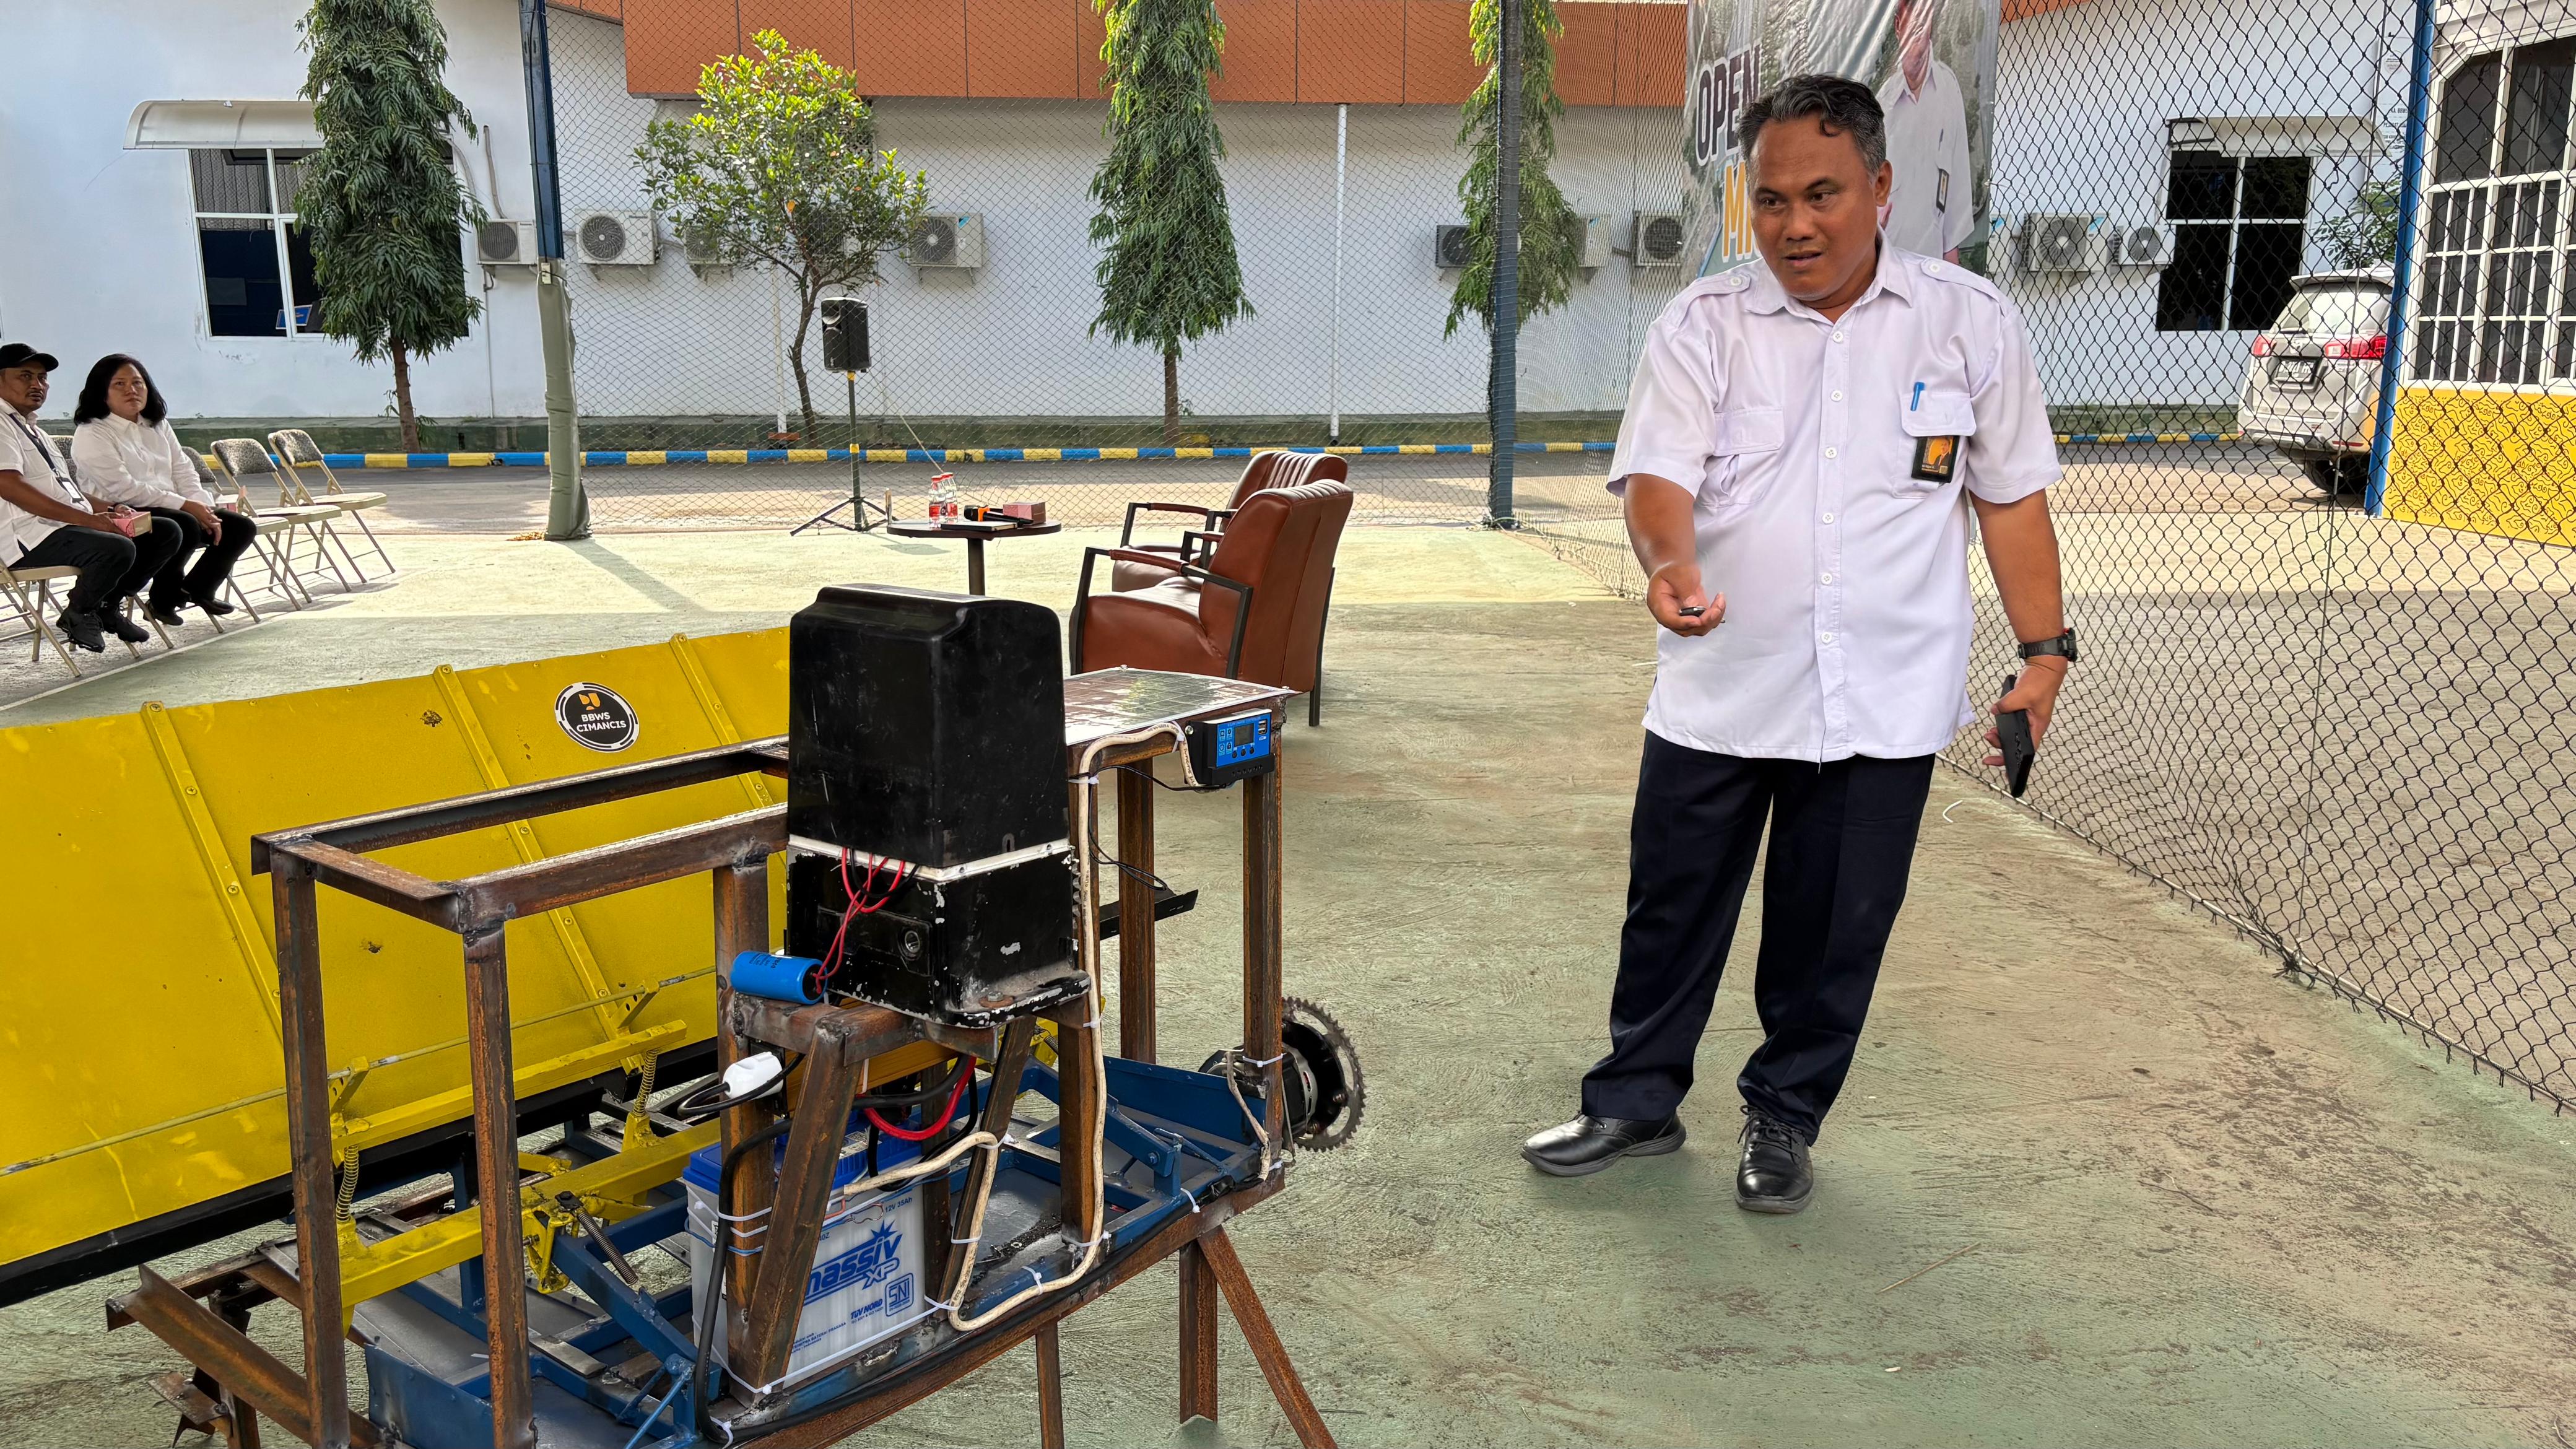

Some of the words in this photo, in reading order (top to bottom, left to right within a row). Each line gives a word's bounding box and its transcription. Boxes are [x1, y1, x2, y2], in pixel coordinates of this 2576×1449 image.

[1697, 43, 1761, 164] OPEN
[1722, 160, 1760, 261] MI
[576, 720, 627, 733] CIMANCIS
[581, 712, 611, 722] BBWS
[885, 1203, 896, 1212] 12V
[897, 1197, 913, 1208] 35Ah
[862, 1257, 900, 1290] XP
[889, 1279, 910, 1306] SNI
